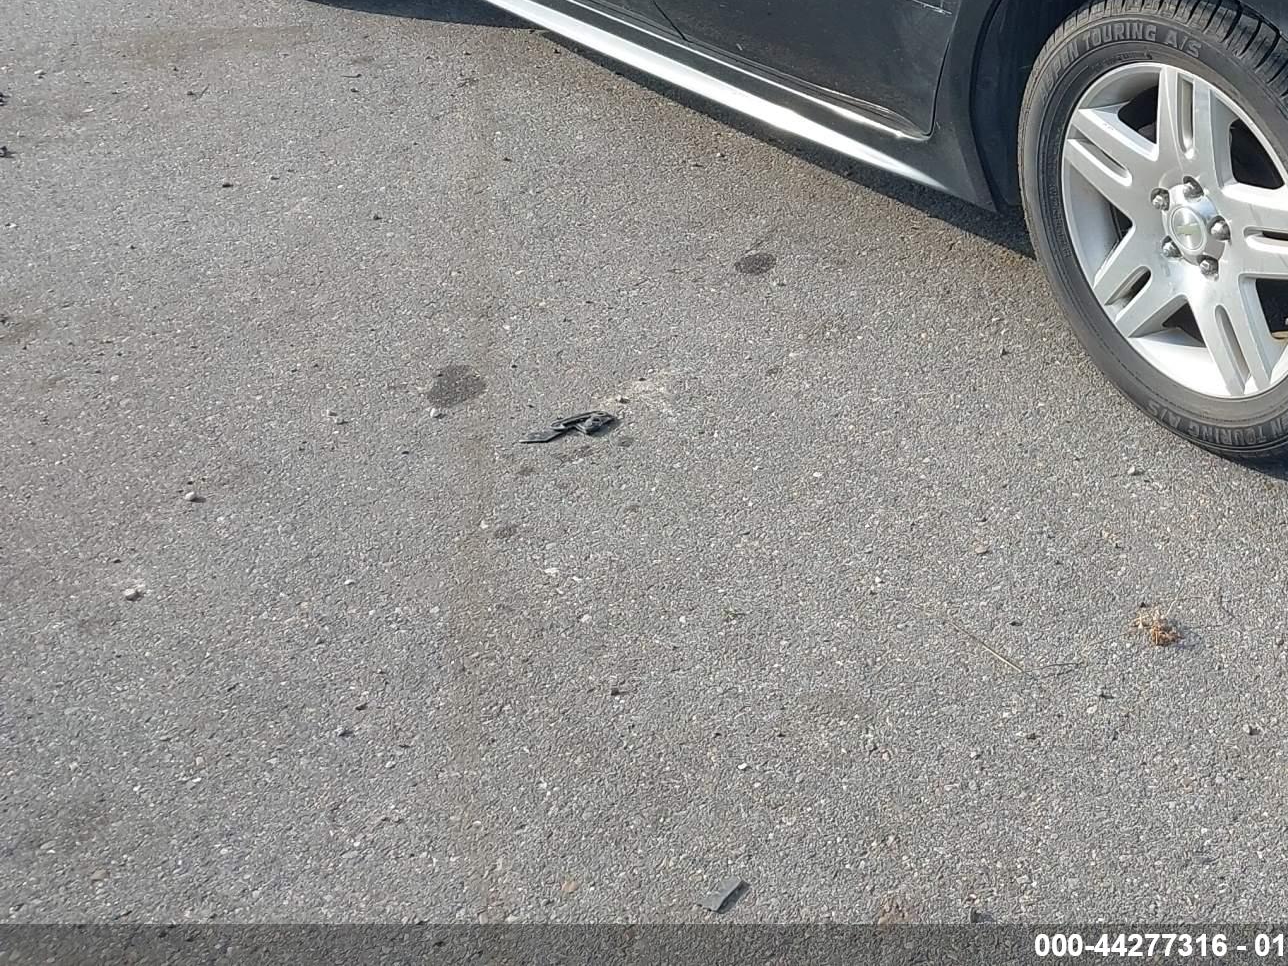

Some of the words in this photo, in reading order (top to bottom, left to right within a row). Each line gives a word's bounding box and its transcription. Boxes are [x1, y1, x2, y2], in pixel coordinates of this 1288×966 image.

[1085, 22, 1157, 50] TOURING
[1165, 30, 1202, 59] A/S
[1188, 420, 1267, 446] TOURING
